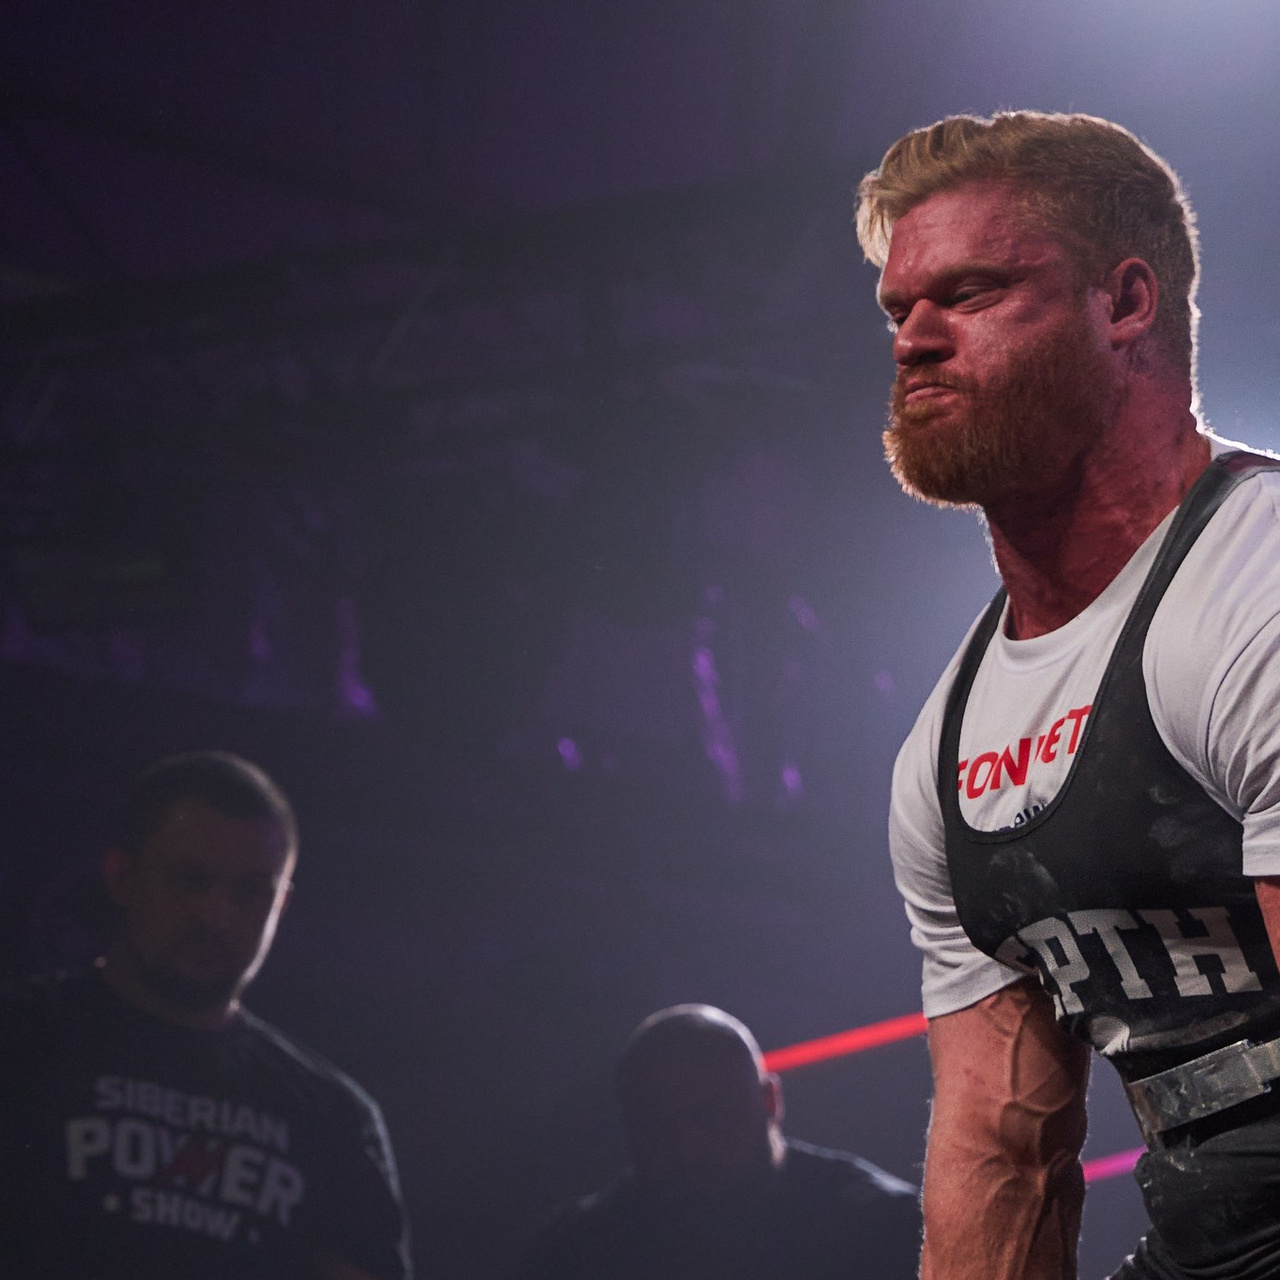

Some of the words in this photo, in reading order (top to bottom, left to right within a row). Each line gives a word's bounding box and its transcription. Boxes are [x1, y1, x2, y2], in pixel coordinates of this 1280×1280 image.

[96, 1076, 289, 1152] SIBERIAN
[66, 1116, 304, 1228] POWER
[131, 1187, 241, 1241] SHOW
